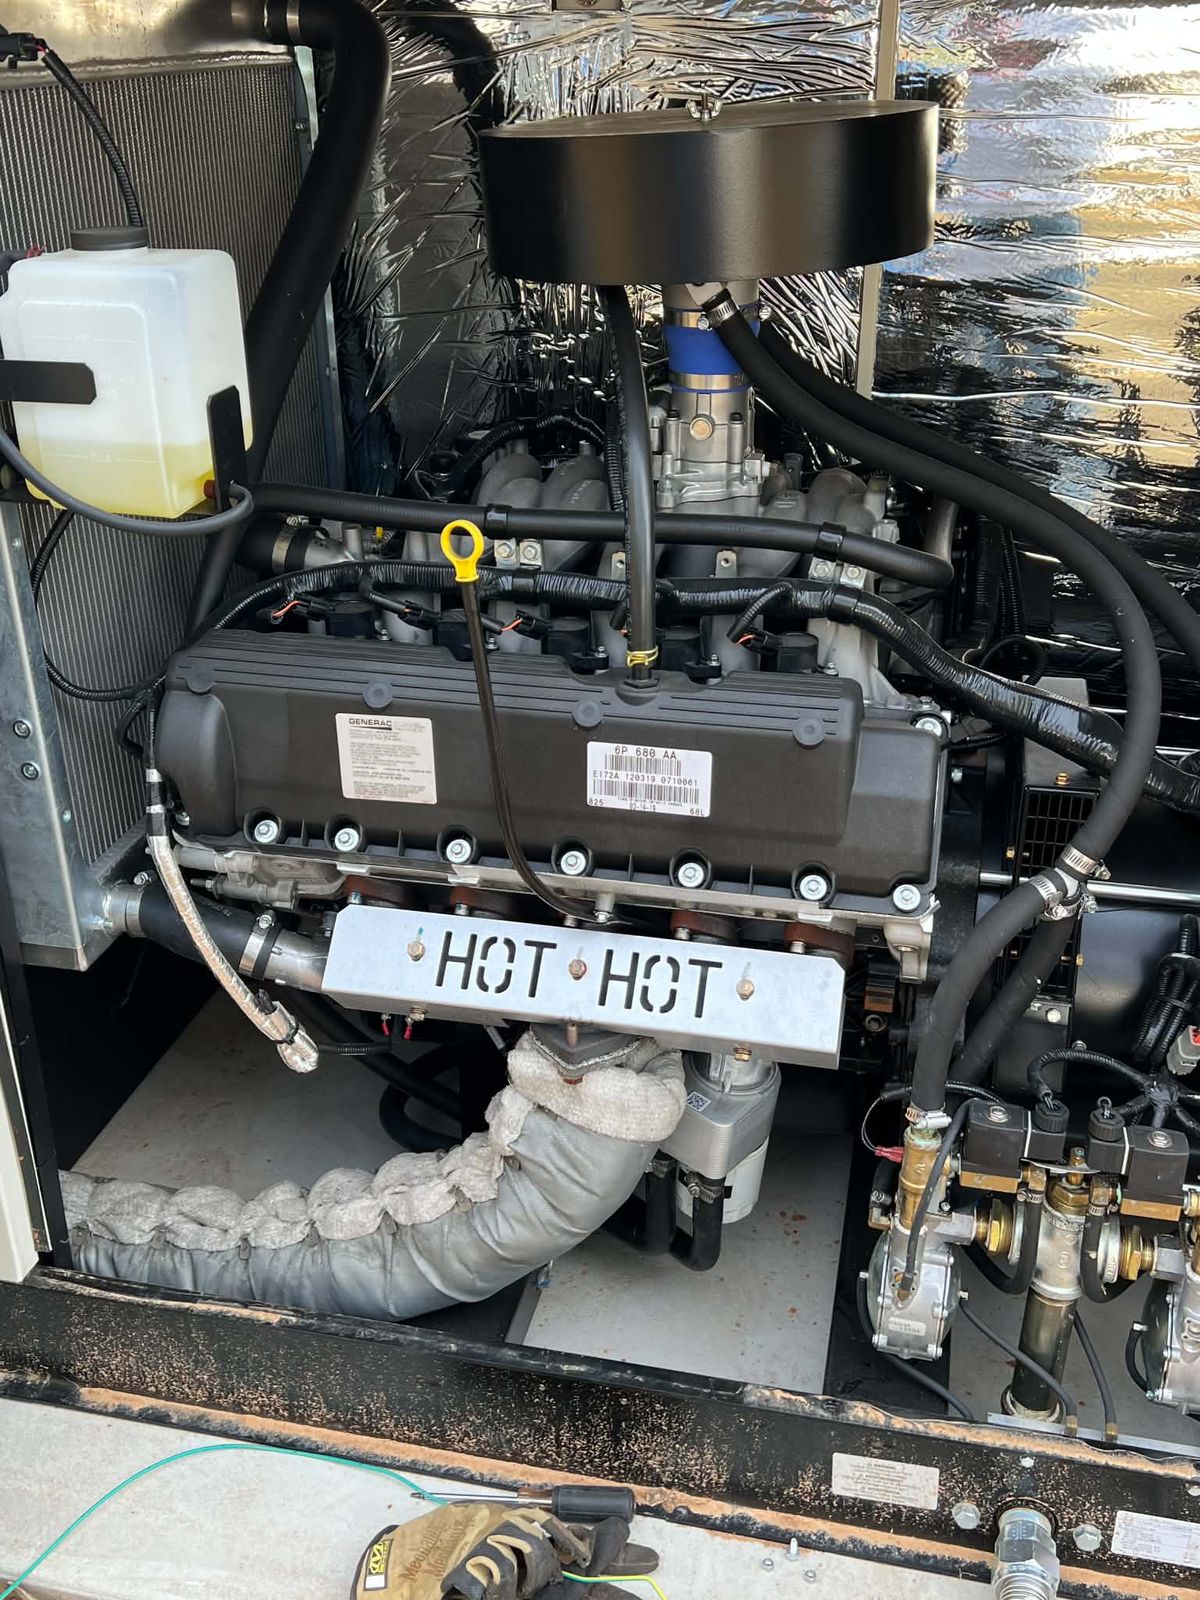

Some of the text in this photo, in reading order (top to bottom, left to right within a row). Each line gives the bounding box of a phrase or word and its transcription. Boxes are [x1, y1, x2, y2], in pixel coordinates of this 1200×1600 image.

[348, 718, 392, 727] GENERAC
[614, 745, 677, 760] 6P 680 AA
[593, 770, 619, 780] E172A
[435, 931, 723, 1019] HOT HOT
